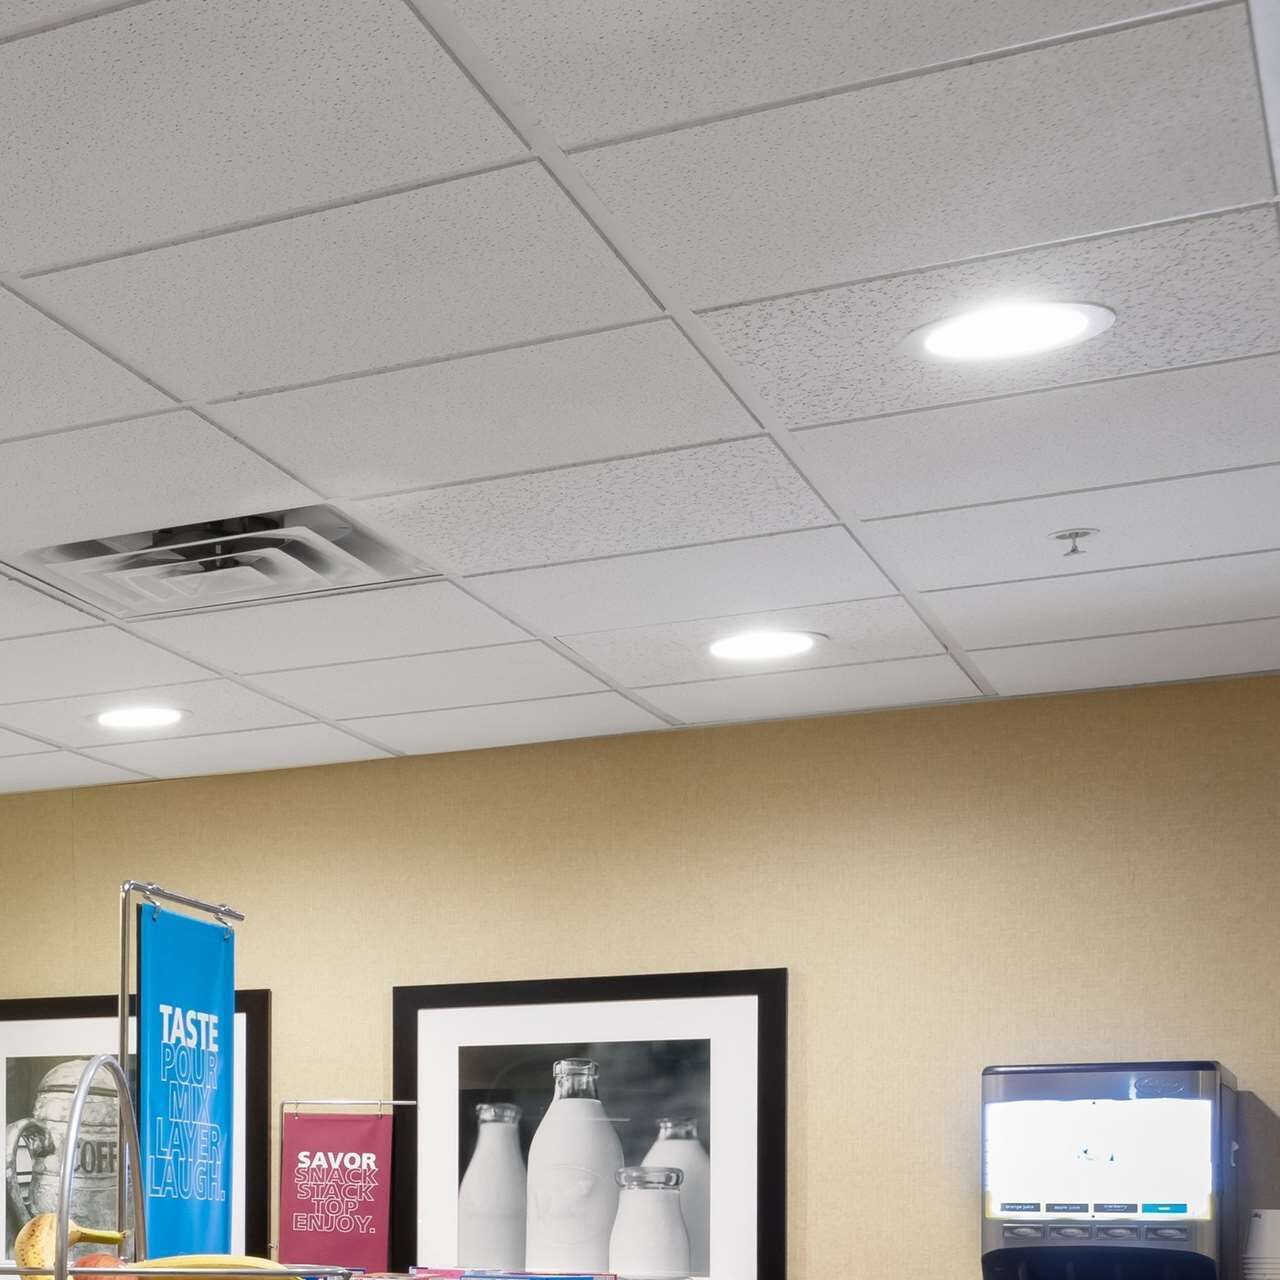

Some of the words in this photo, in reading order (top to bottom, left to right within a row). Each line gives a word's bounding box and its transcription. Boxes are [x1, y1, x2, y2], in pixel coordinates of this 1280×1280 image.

[159, 1004, 219, 1052] TASTE
[160, 1042, 218, 1089] POUR
[169, 1081, 210, 1122] MIX
[156, 1117, 221, 1164] LAYER
[298, 1151, 377, 1169] SAVOR
[149, 1156, 225, 1202] LAUGH.
[295, 1167, 378, 1185] SNACK
[297, 1183, 374, 1201] STACK
[312, 1198, 359, 1216] TOP
[293, 1213, 376, 1233] ENJOY.
